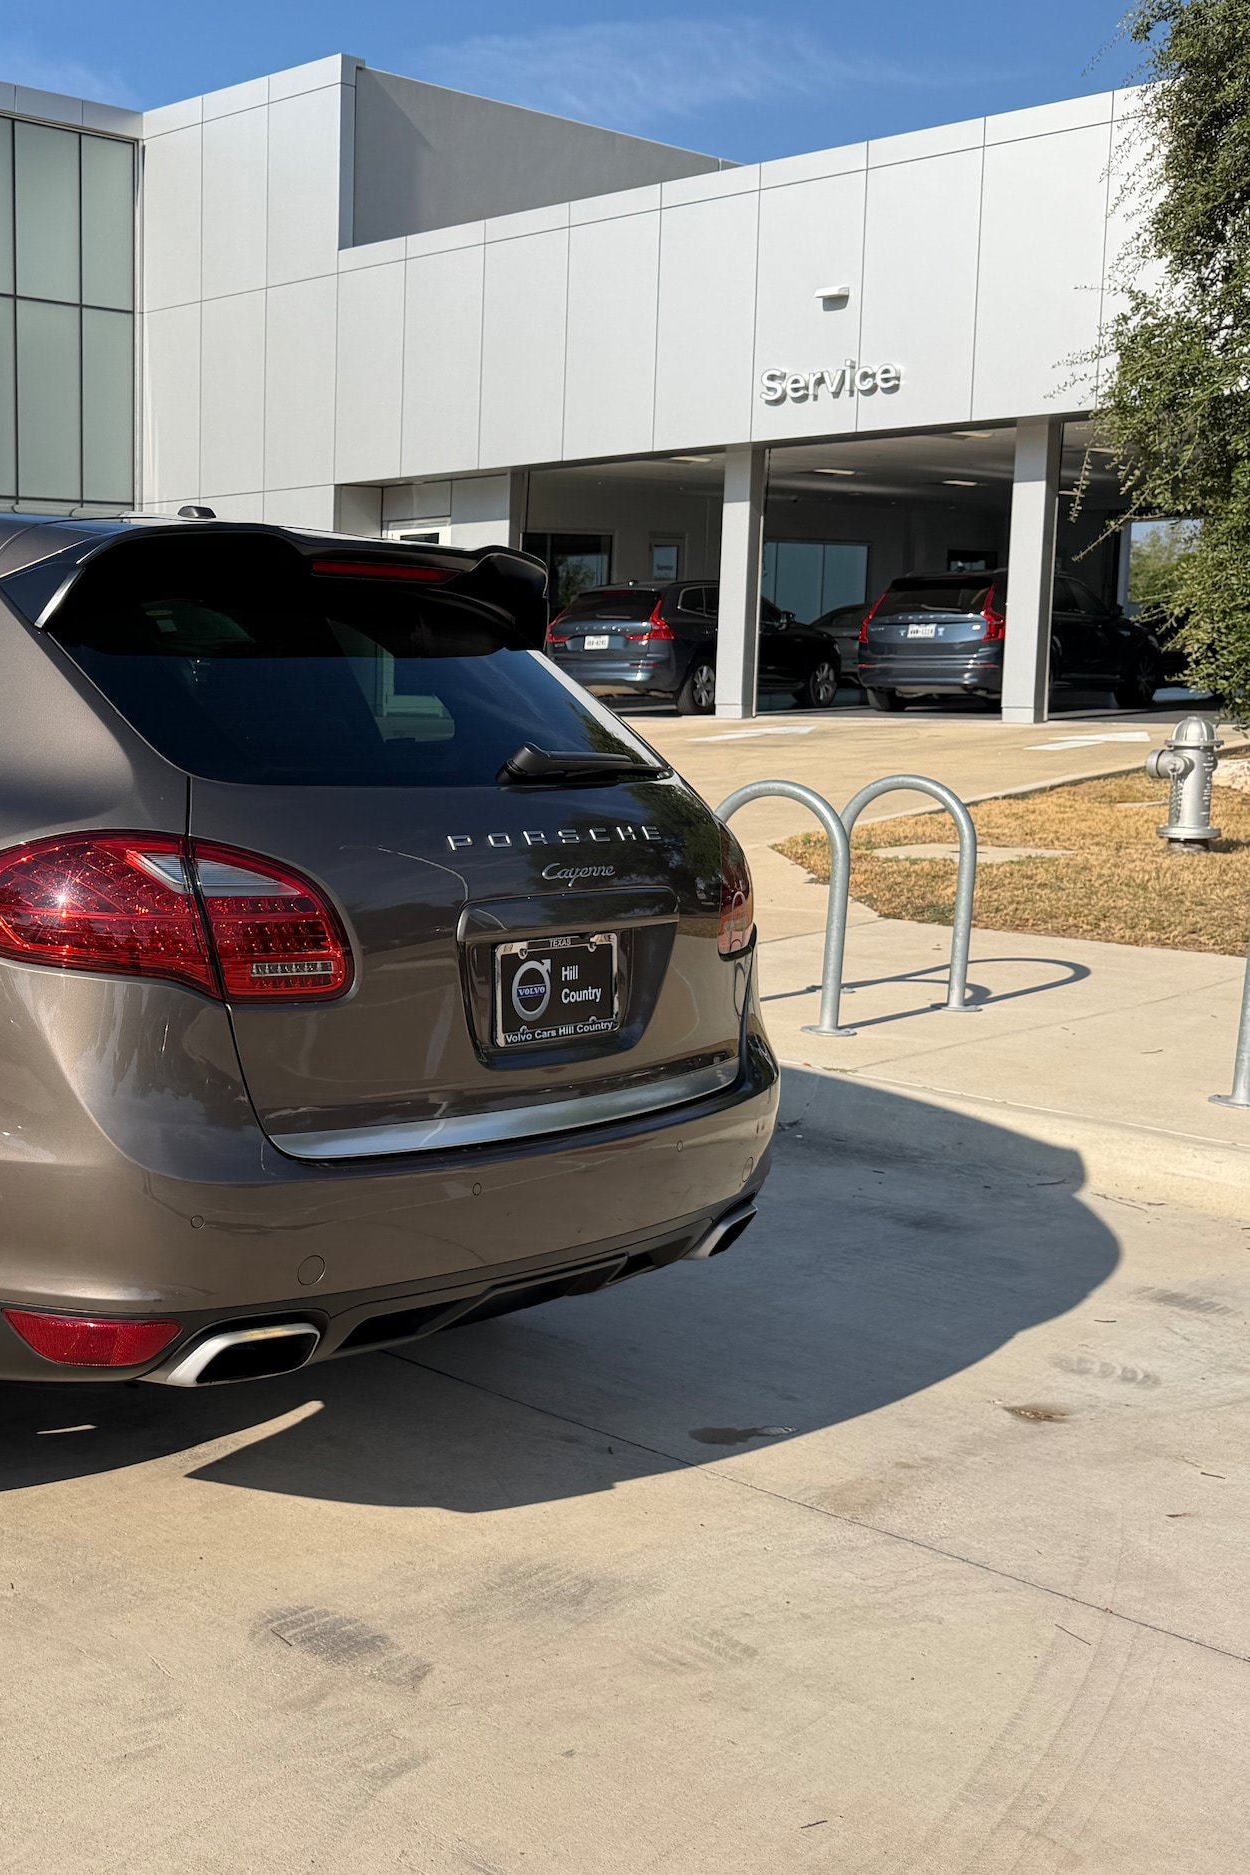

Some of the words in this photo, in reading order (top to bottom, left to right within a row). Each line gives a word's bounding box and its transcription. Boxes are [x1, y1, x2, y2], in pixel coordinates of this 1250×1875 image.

[760, 358, 900, 404] Service
[447, 825, 662, 851] PORSCHE
[542, 863, 616, 887] Cayenne
[549, 938, 572, 948] TEXAS
[561, 965, 579, 981] Hill
[518, 986, 546, 996] VOLVO
[561, 986, 602, 1003] Country
[506, 1031, 533, 1043] Volvo
[534, 1029, 557, 1039] Cars
[558, 1025, 575, 1036] Hill
[576, 1020, 613, 1033] Country
